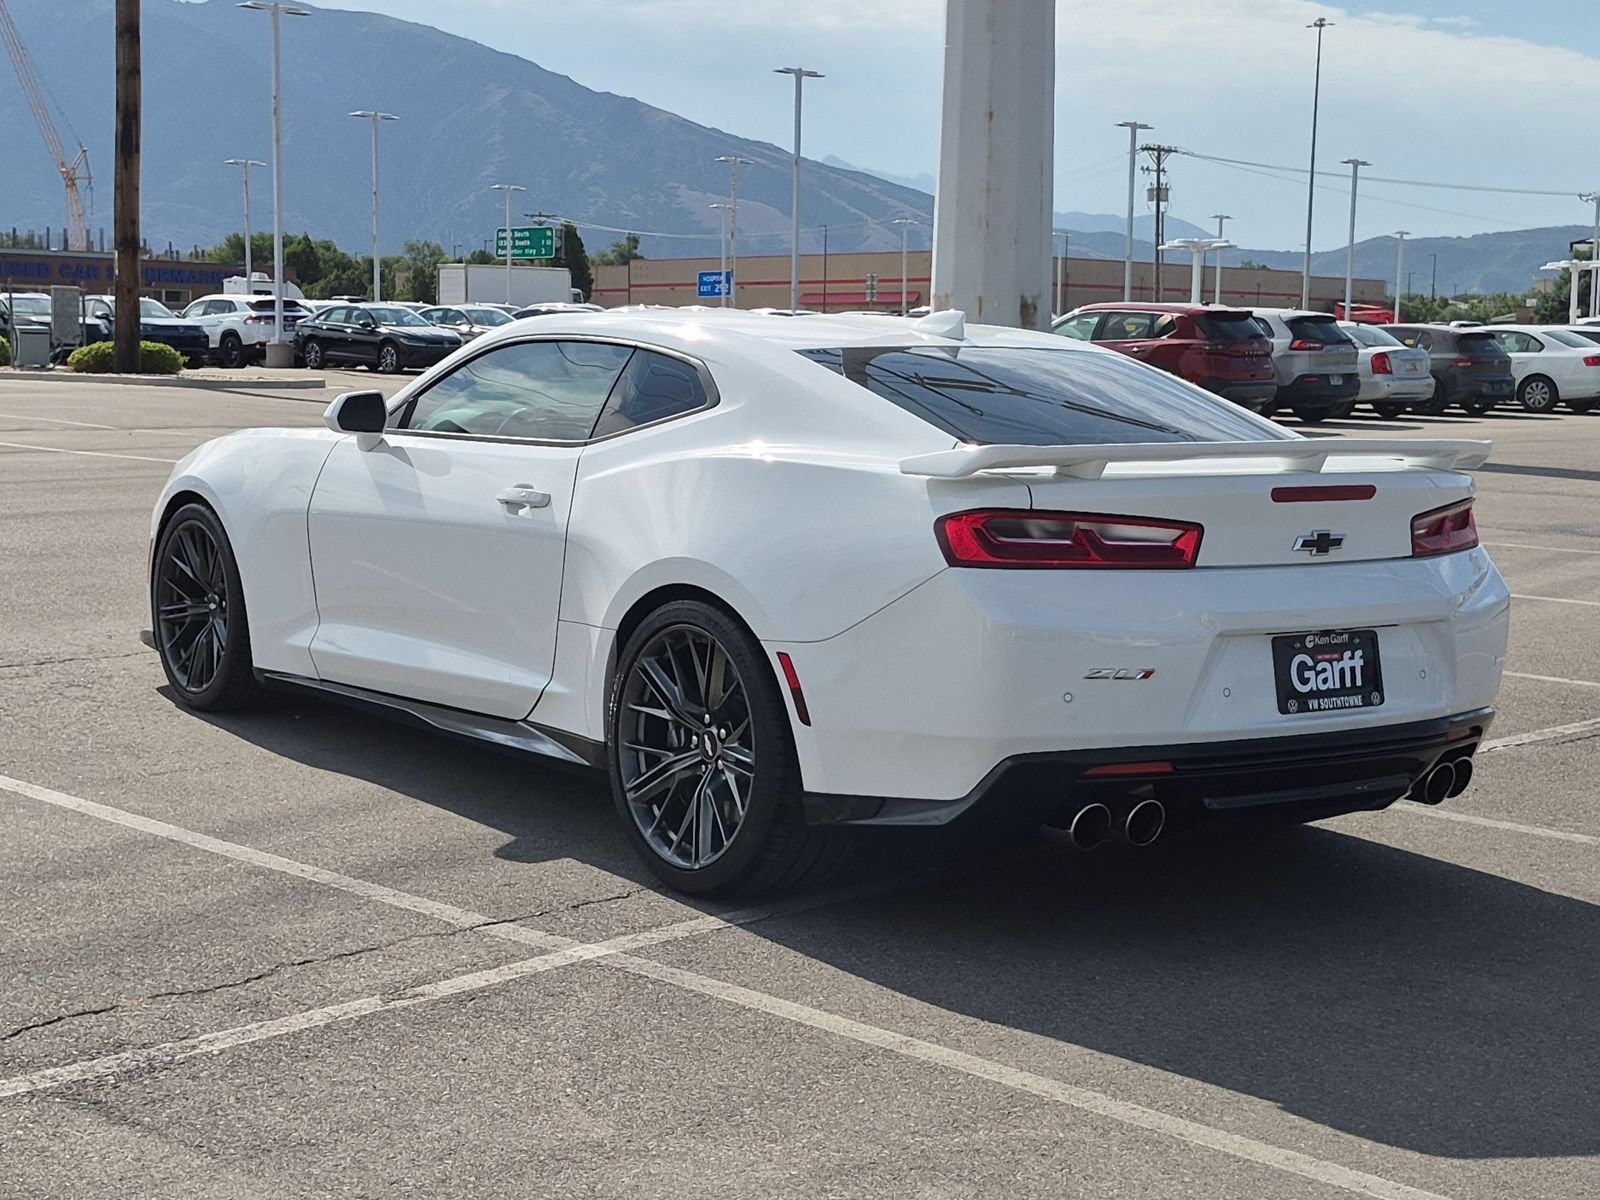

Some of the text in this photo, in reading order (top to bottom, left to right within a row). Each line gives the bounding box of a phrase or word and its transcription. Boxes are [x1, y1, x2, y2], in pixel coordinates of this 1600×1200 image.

[59, 263, 102, 281] CAR
[1315, 634, 1349, 645] Ken Garff
[1083, 668, 1156, 680] ZL1
[1290, 649, 1364, 694] Garff
[1307, 695, 1363, 711] VW SOUTHTOWNE
